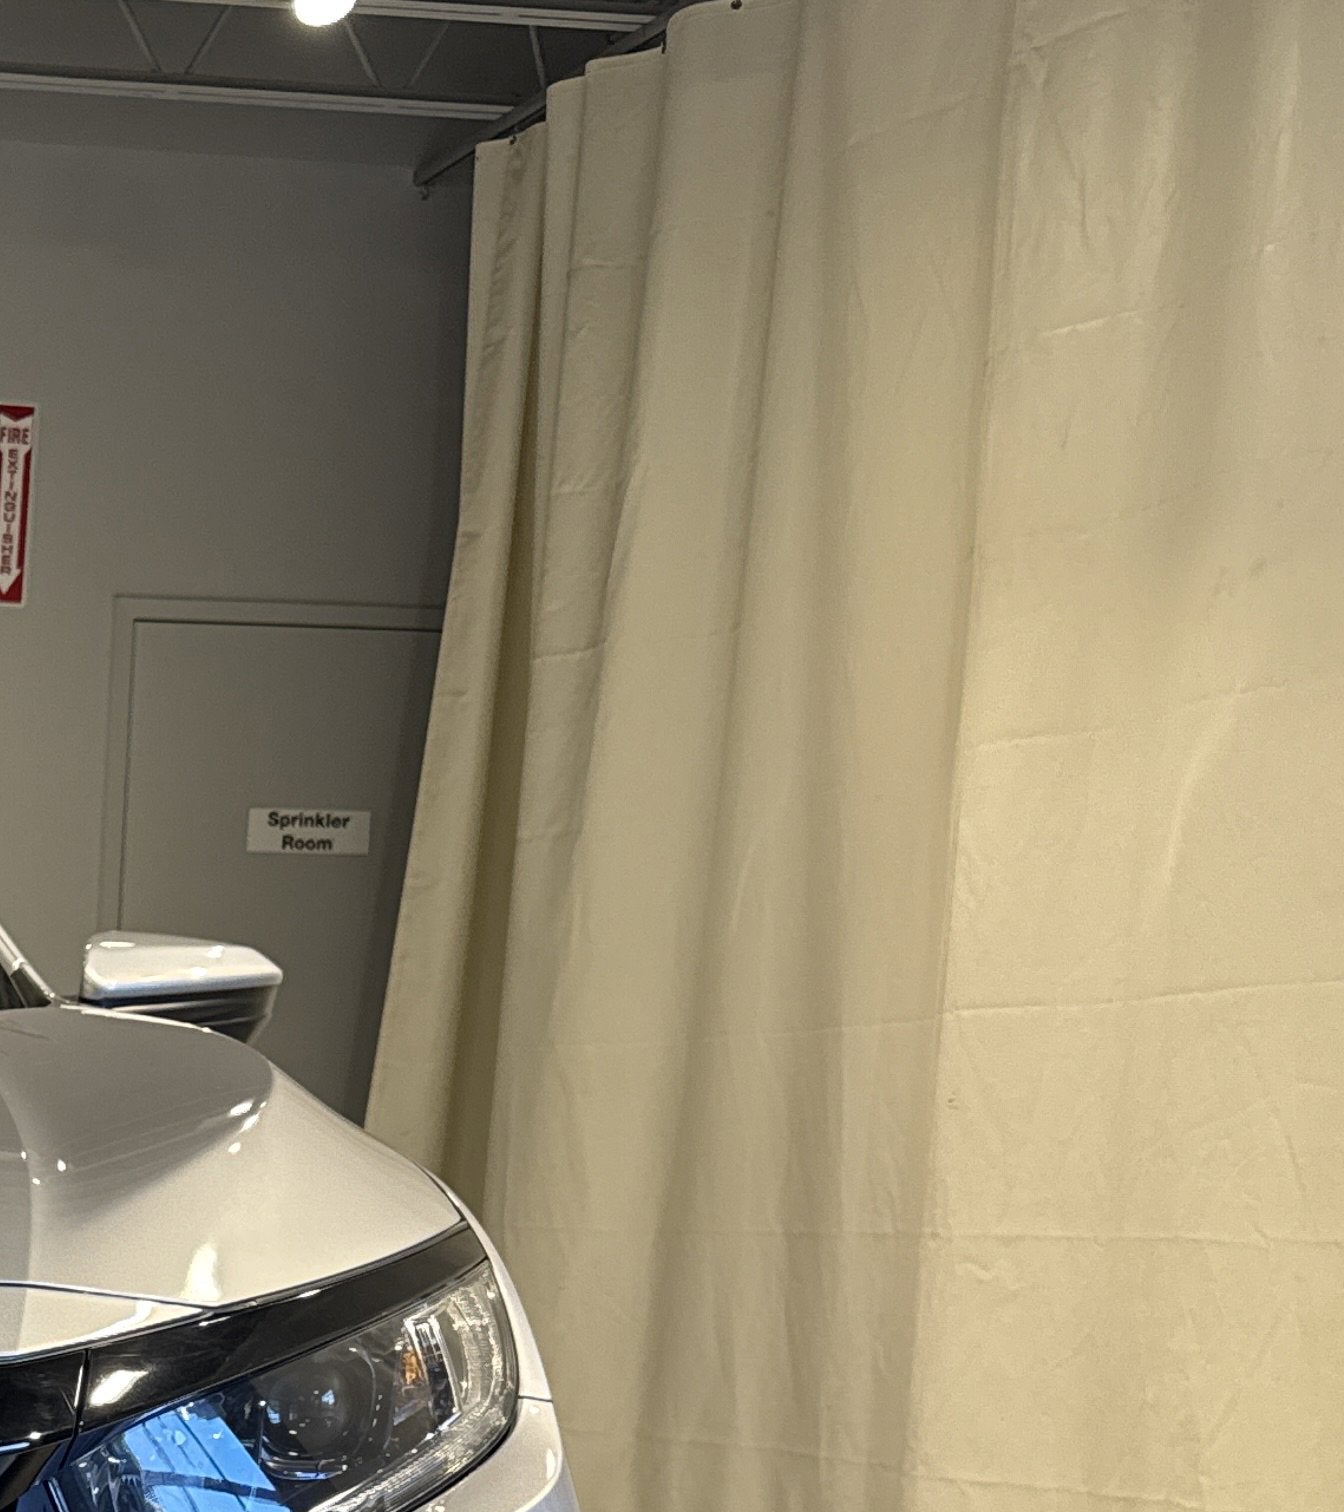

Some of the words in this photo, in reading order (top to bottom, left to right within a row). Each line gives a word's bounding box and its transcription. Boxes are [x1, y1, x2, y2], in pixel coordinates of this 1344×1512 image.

[0, 427, 30, 445] FIRE
[268, 812, 351, 831] Sprinkler
[282, 835, 333, 851] Room
